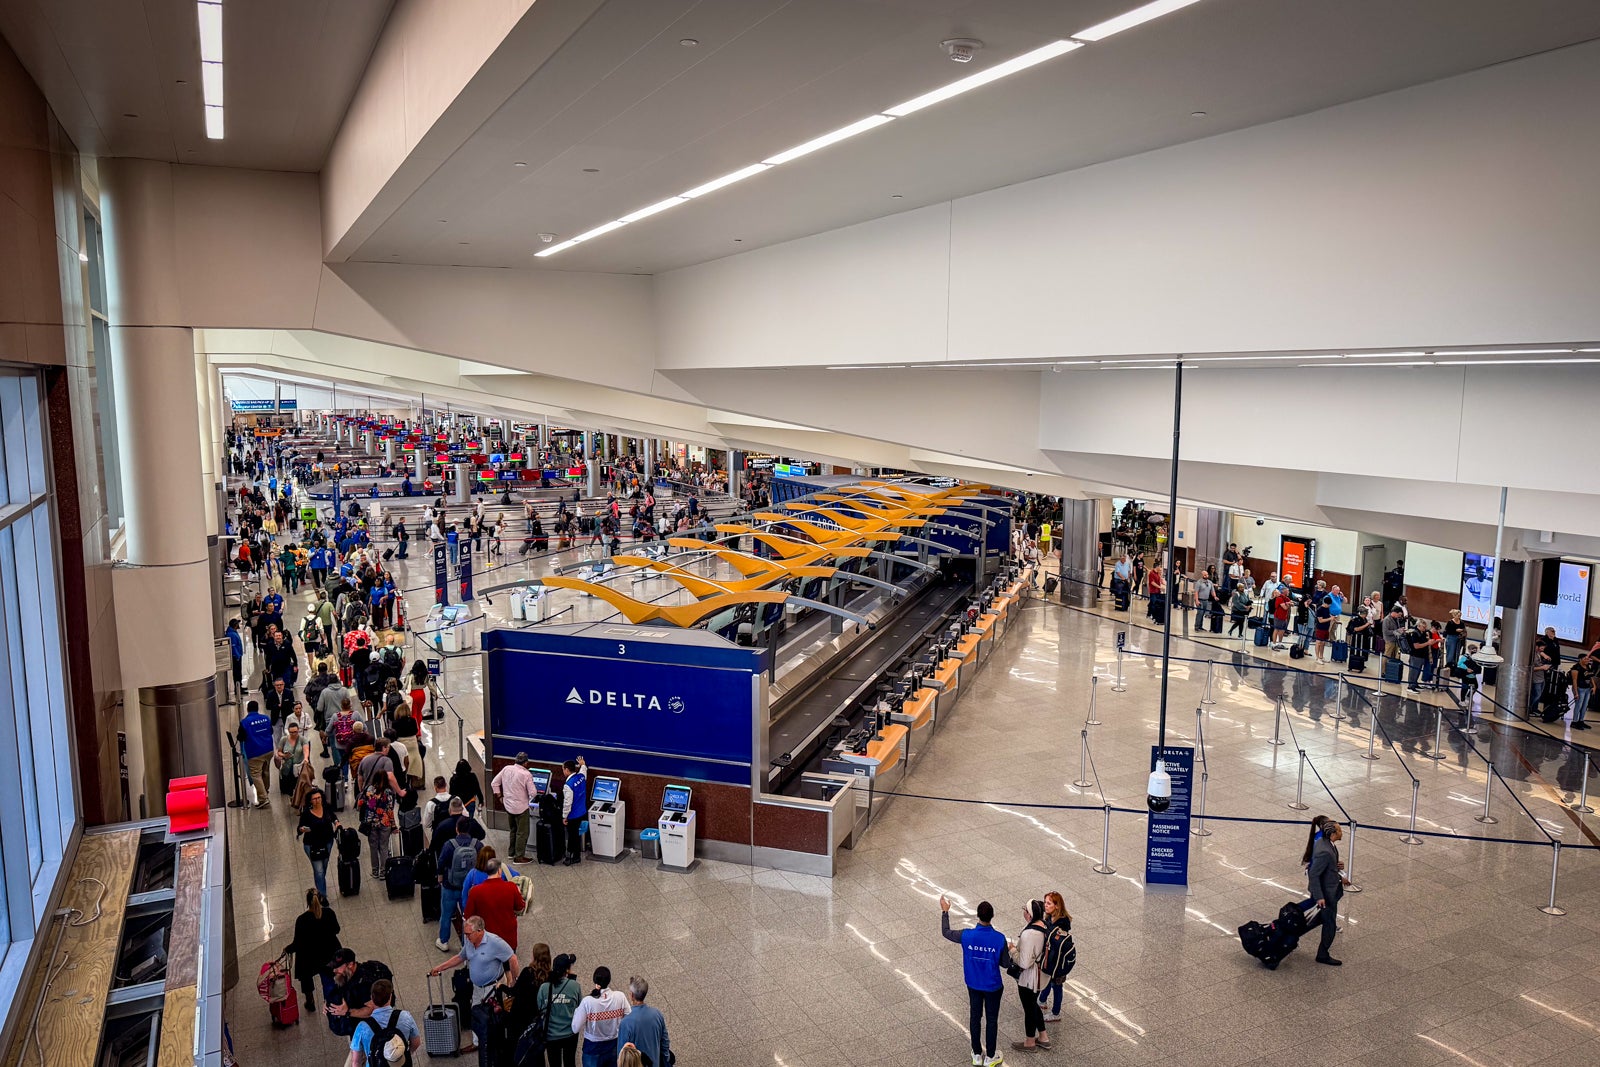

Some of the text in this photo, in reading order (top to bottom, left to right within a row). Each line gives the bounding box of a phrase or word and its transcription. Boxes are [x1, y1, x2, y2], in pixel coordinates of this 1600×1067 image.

[408, 455, 414, 463] 2
[540, 452, 545, 460] 2
[448, 471, 452, 480] 1
[618, 643, 626, 655] 3
[589, 689, 662, 711] DELTA
[1152, 823, 1180, 831] PASSENGER
[973, 945, 996, 953] DELTA
